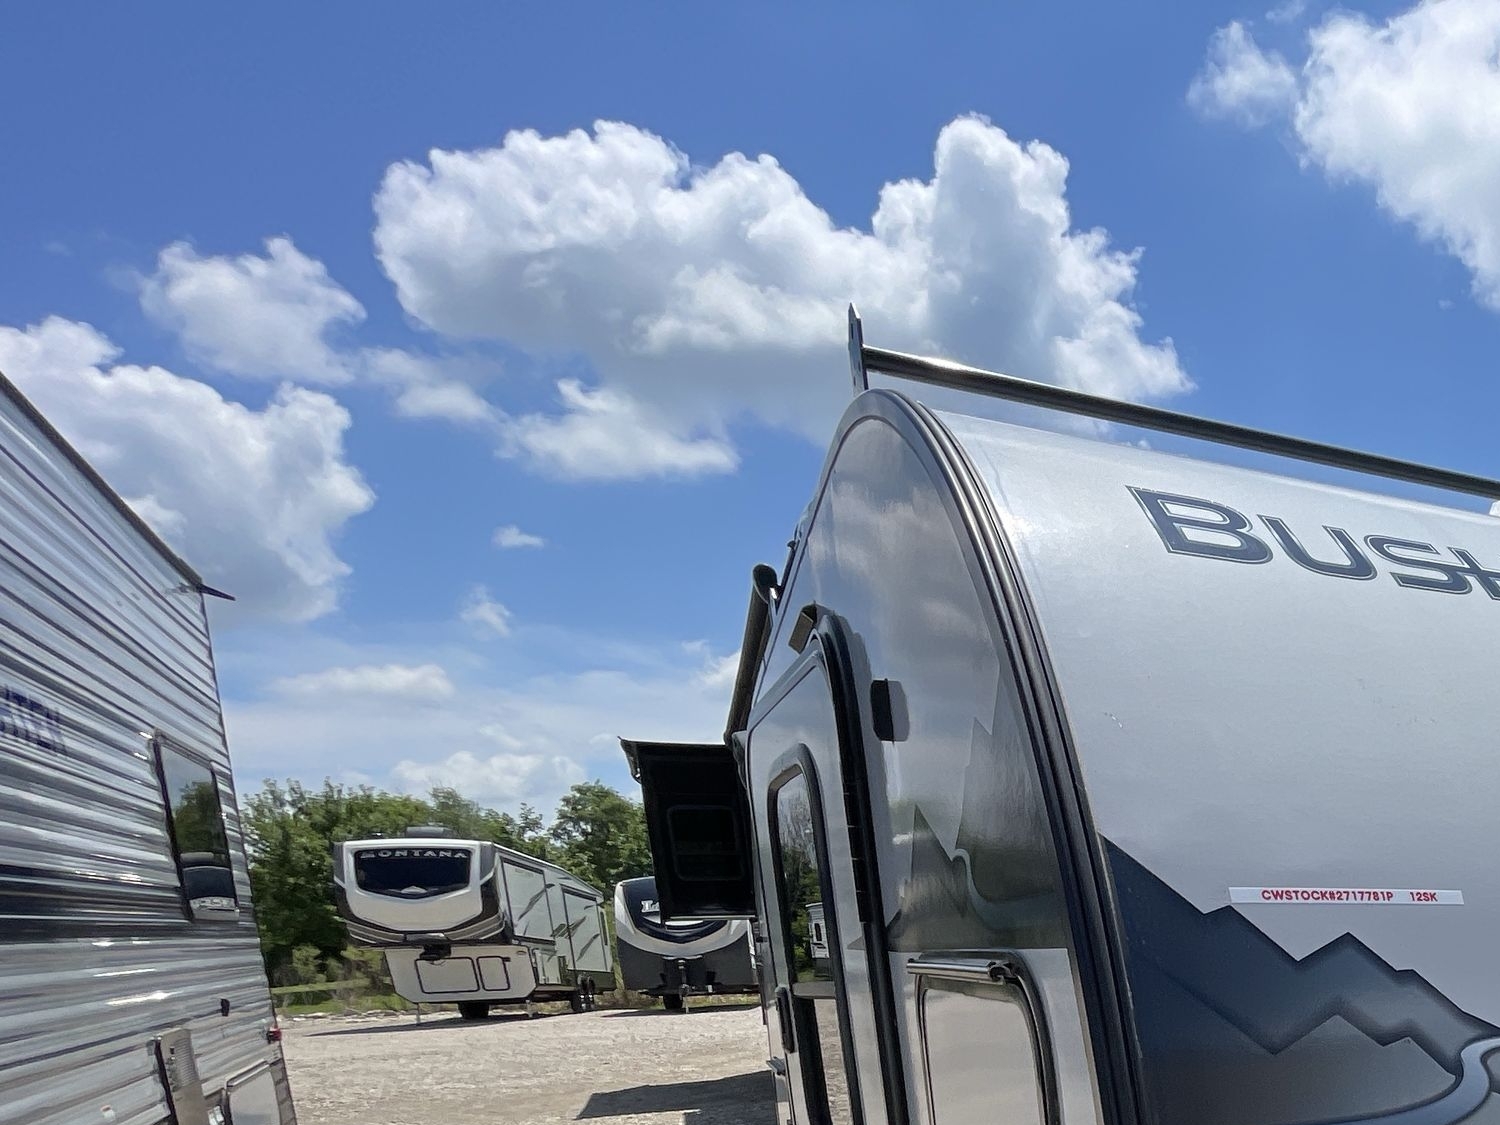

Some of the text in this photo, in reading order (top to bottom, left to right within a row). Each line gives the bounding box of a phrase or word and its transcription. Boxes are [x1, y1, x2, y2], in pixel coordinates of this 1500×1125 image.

[360, 849, 468, 859] MONTANA
[1261, 889, 1438, 902] CWSTOCK#2717781P 12SK
